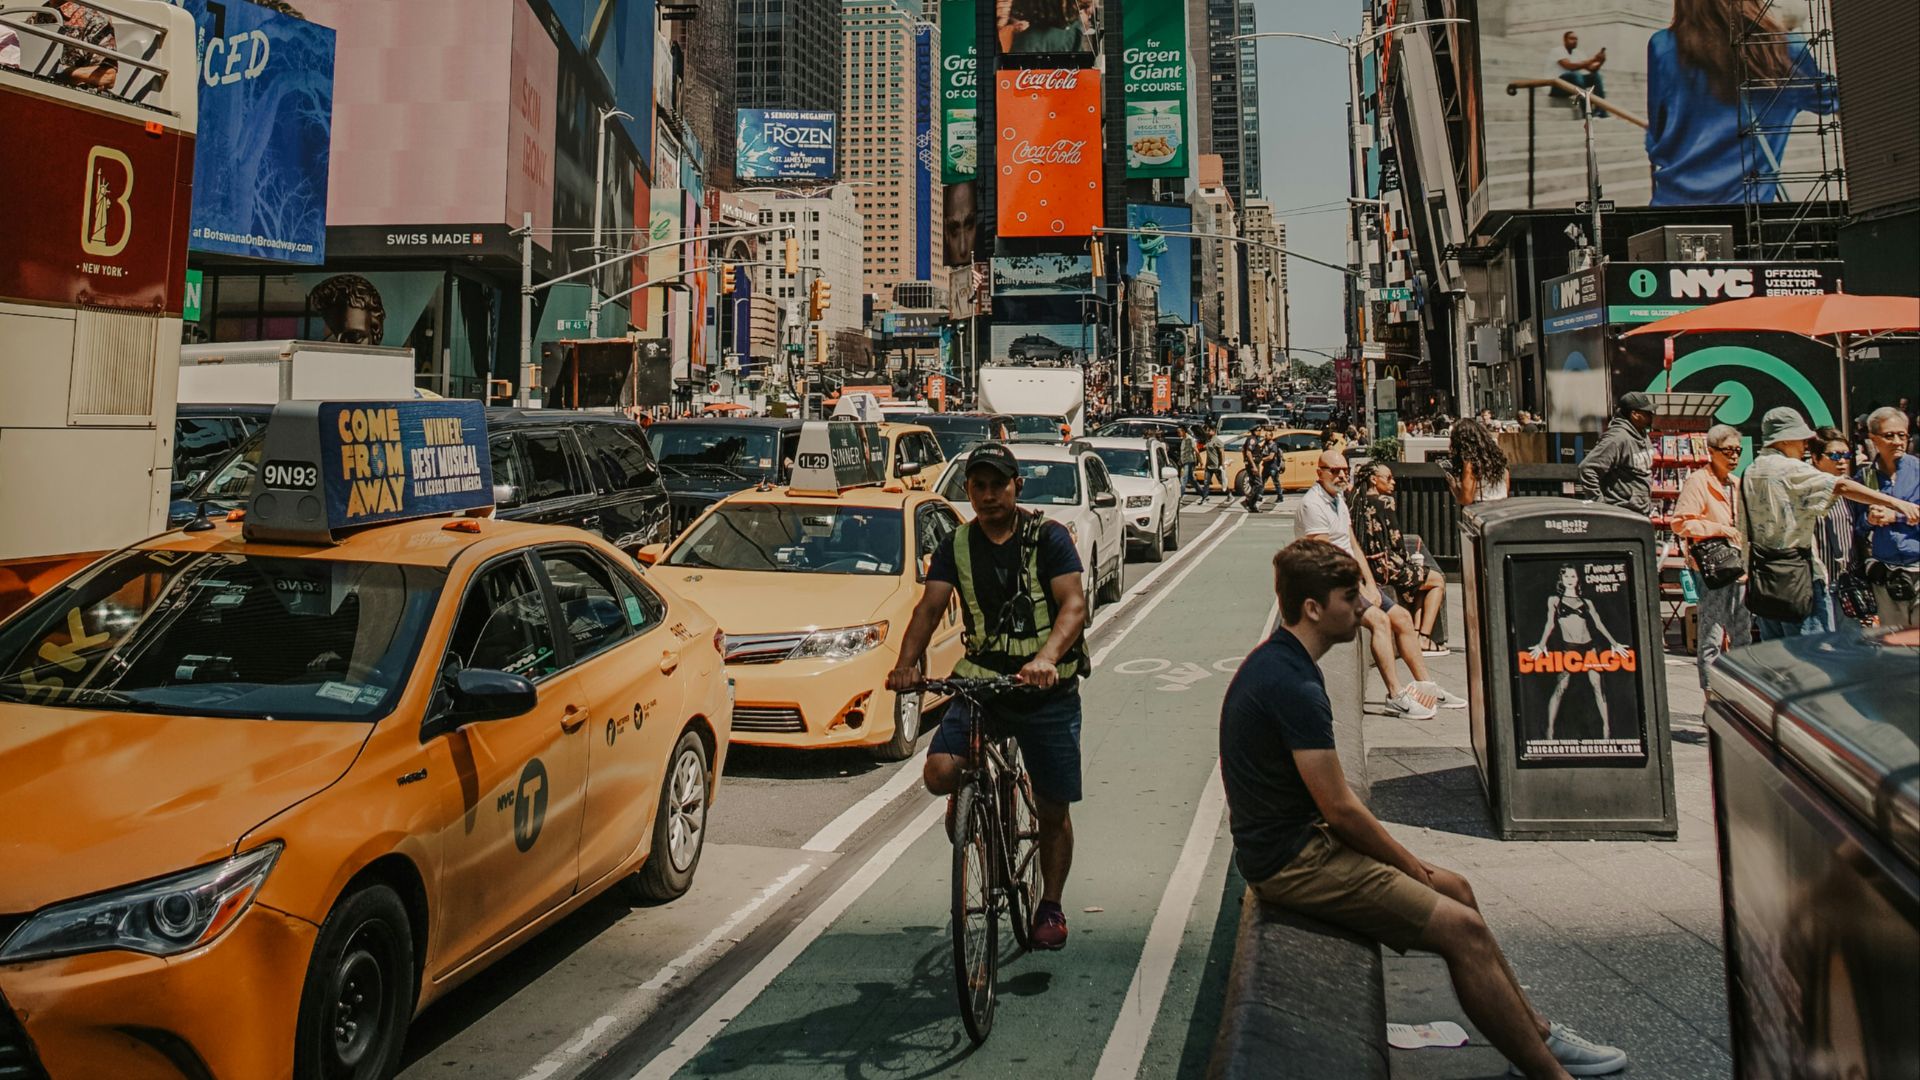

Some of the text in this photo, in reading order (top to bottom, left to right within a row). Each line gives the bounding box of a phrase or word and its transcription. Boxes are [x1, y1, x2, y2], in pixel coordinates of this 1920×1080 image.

[1147, 38, 1160, 48] for
[1123, 48, 1180, 64] Green
[1015, 68, 1081, 90] Coca-Cola
[1130, 64, 1183, 80] Giant
[946, 90, 960, 99] OF
[1124, 82, 1185, 93] OF COURSE.
[764, 122, 832, 148] FROZEN
[1012, 139, 1087, 164] Coca-Cola
[193, 228, 313, 253] at BotswanaOnBroadway.com
[387, 234, 470, 245] SWISS MADE
[82, 262, 122, 277] NEW YORK
[1560, 278, 1580, 309] NYC
[1670, 269, 1822, 297] NYC OFFICIAL
[1766, 279, 1816, 287] VISITOR
[1381, 290, 1388, 300] W
[1392, 290, 1401, 299] 45
[338, 408, 400, 443] COME
[423, 418, 464, 446] WINNER!
[341, 443, 405, 480] FROM
[411, 445, 480, 479] BEST MUSICAL
[800, 456, 826, 468] 1L29
[832, 447, 860, 466] SINNER
[265, 465, 316, 486] 9N93
[347, 476, 405, 517] AWAY
[414, 481, 424, 497] ALL
[425, 479, 445, 496] ACROSS
[461, 476, 482, 492] AMERICA
[1545, 520, 1588, 529] BigBelly
[1518, 650, 1636, 673] CHICAGO
[1526, 745, 1641, 754] CHICAGOTHEMUSICAL.COM
[497, 790, 514, 812] NYC
